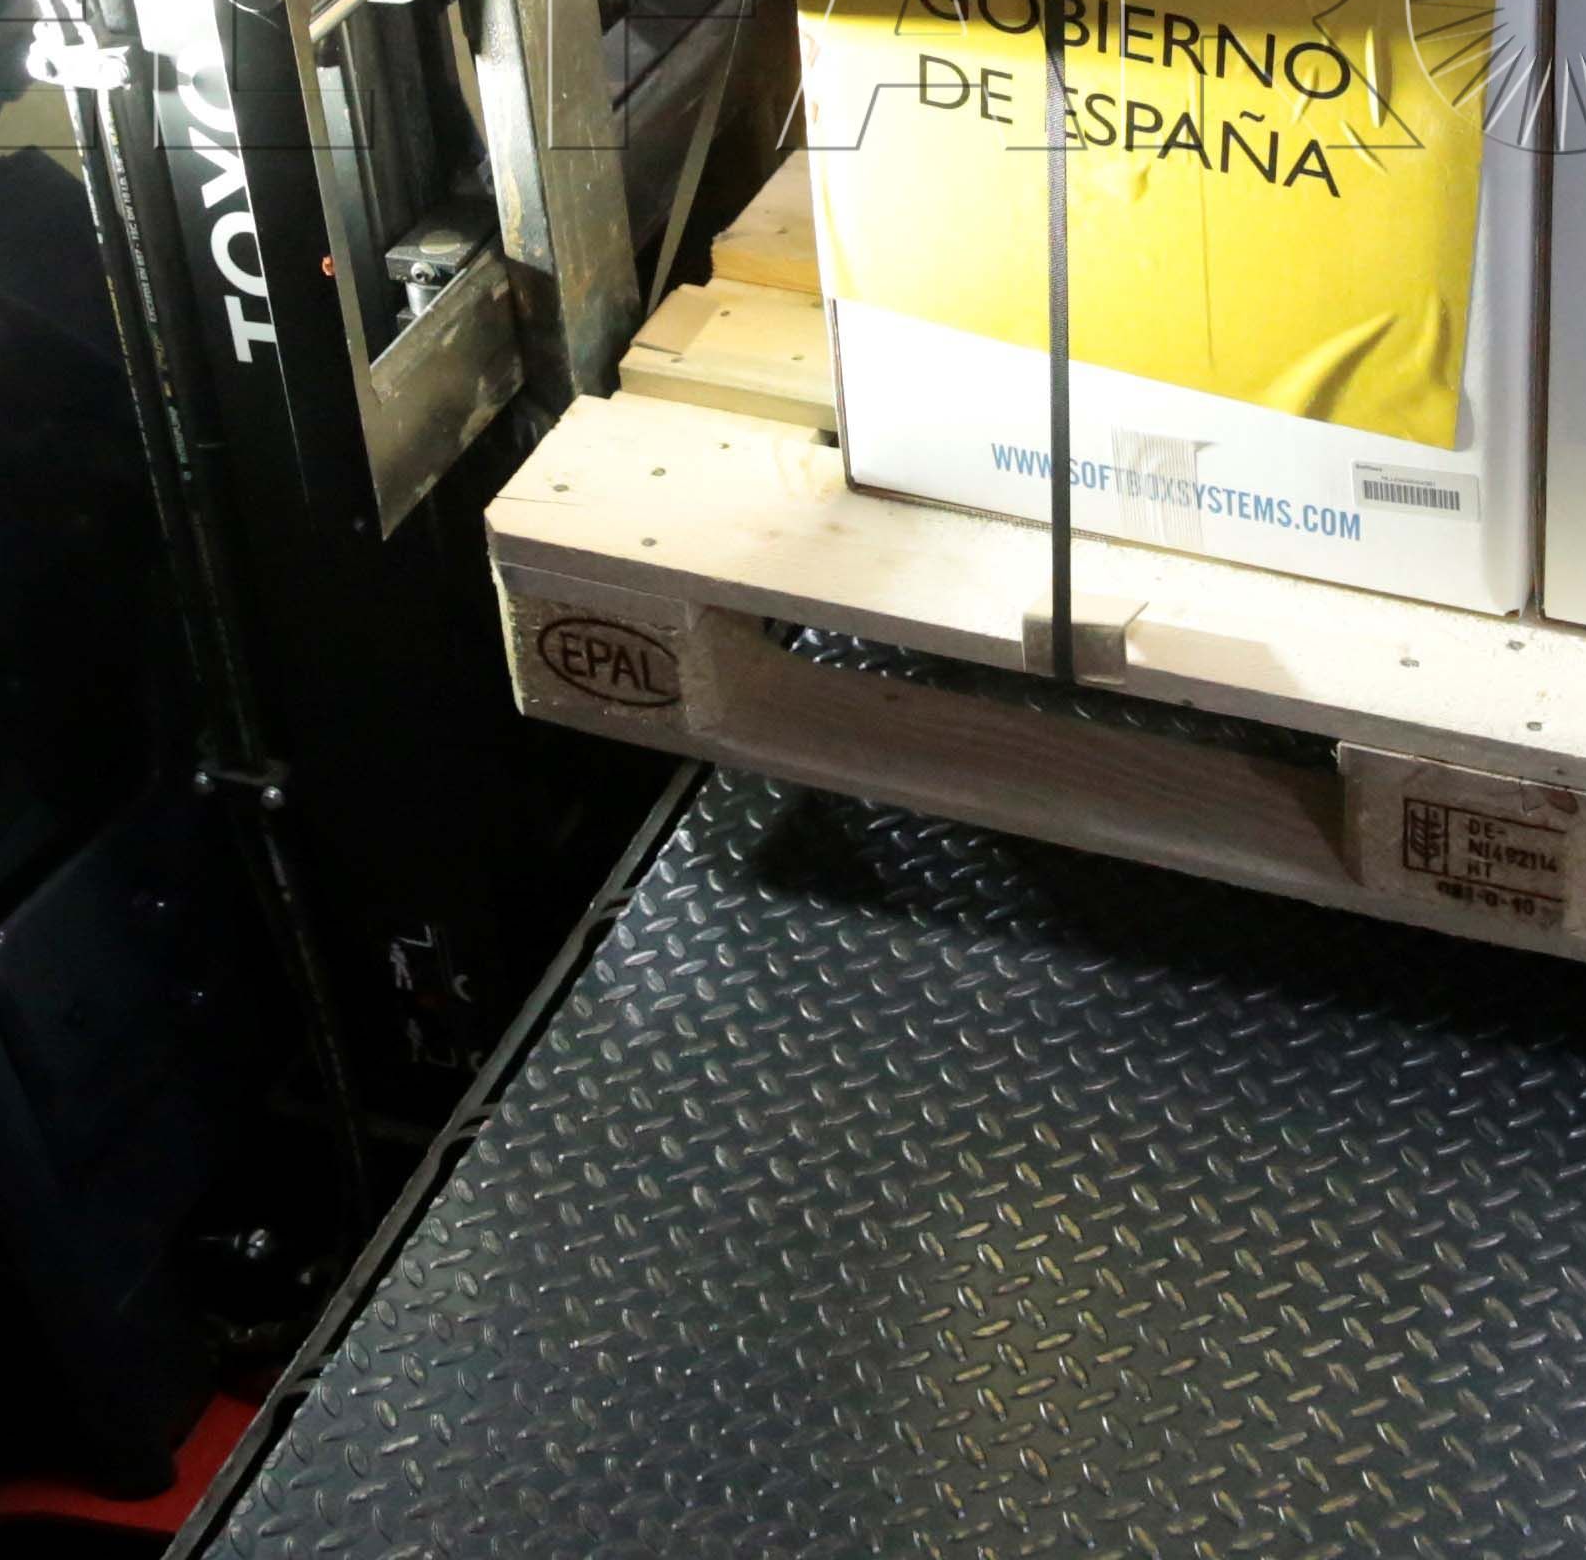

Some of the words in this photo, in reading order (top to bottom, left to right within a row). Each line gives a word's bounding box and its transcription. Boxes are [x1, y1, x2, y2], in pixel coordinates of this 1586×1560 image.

[918, 54, 1013, 124] DE
[991, 443, 1361, 541] WWWSOFTBOXSYSTEMS.COM
[558, 631, 678, 697] EPAL
